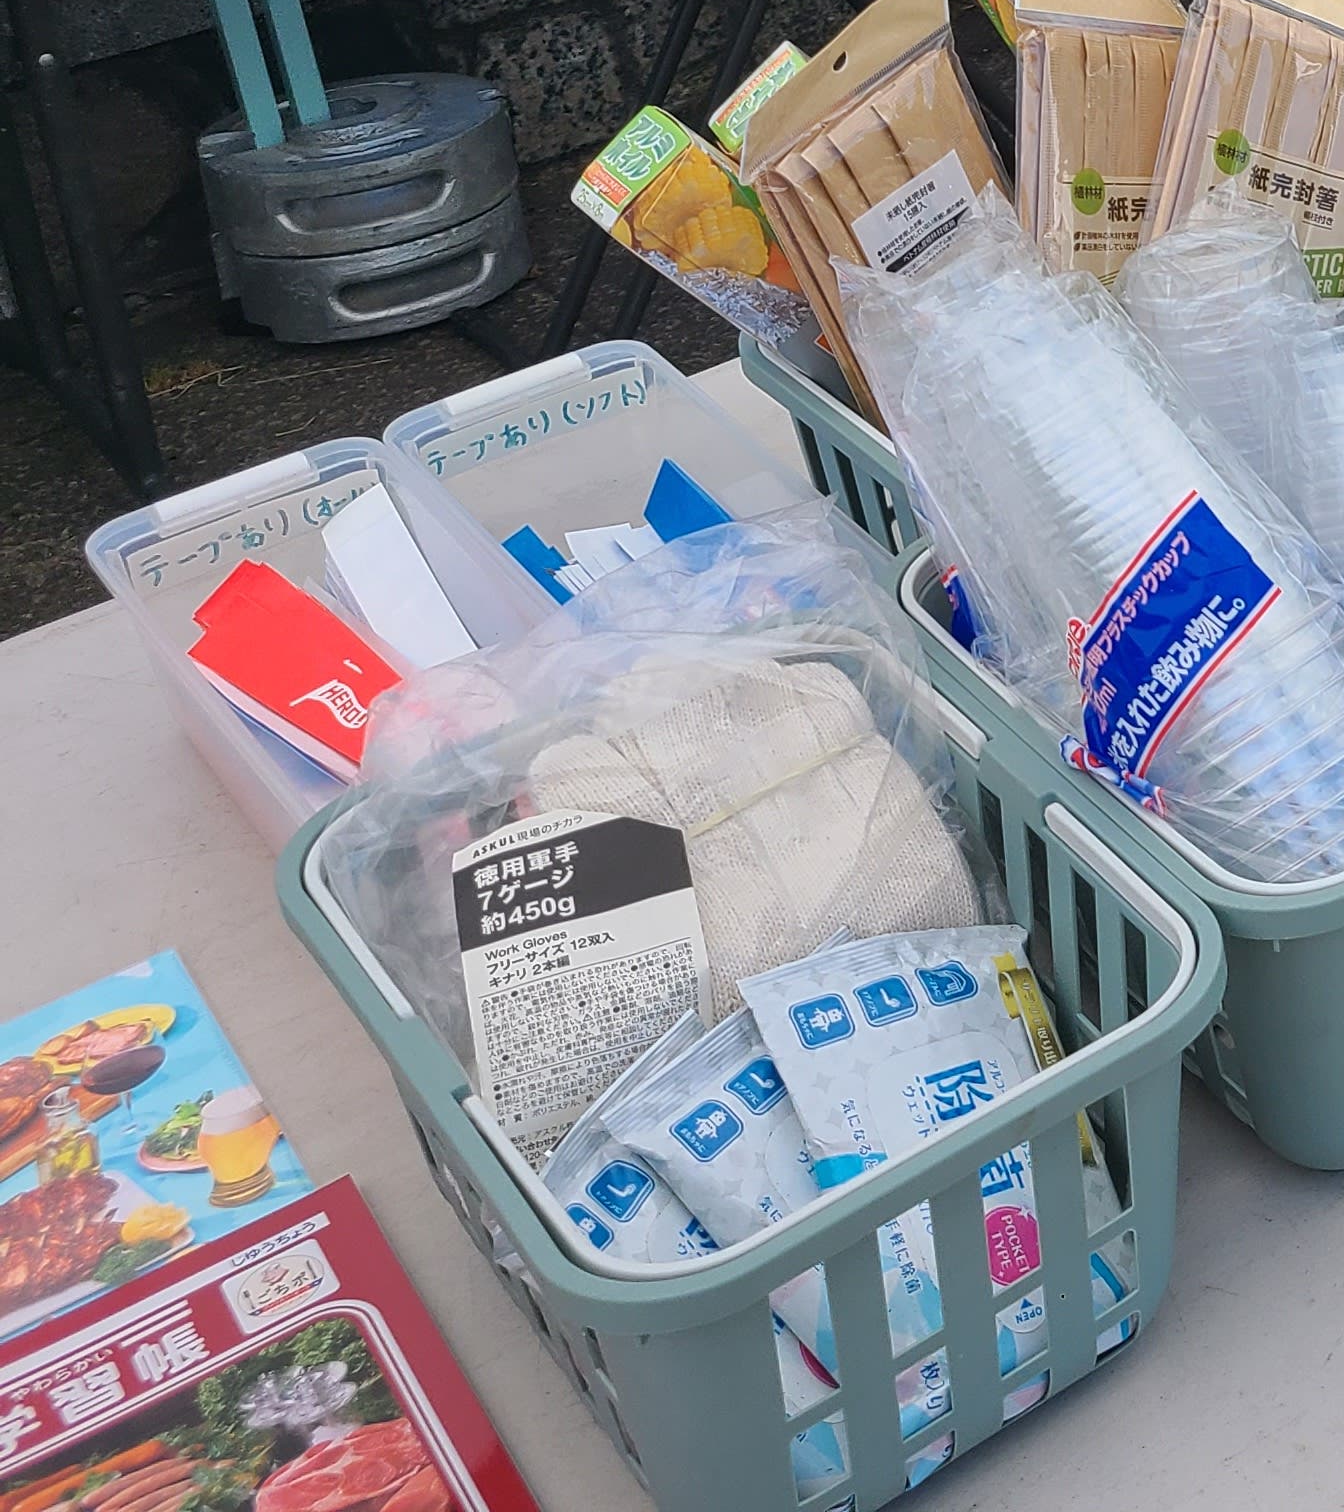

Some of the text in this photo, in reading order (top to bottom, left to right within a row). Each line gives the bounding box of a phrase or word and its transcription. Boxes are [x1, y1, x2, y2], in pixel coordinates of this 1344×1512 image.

[603, 138, 653, 181] ホイル
[625, 112, 677, 164] アルミ
[1248, 163, 1340, 214] 紙完封箸
[472, 815, 583, 859] ASKUL 現場のチカラ
[473, 840, 580, 889] 徳用軍手
[477, 865, 575, 911] 7ゲージ
[480, 895, 576, 935] 約450g
[484, 930, 568, 961] Work Gloves
[486, 931, 616, 976] フリーサイズ 12双入
[488, 968, 528, 989] キナリ
[991, 1230, 1013, 1271] TYPE
[1000, 1213, 1032, 1274] POCKET
[1015, 1306, 1044, 1325] OPEN
